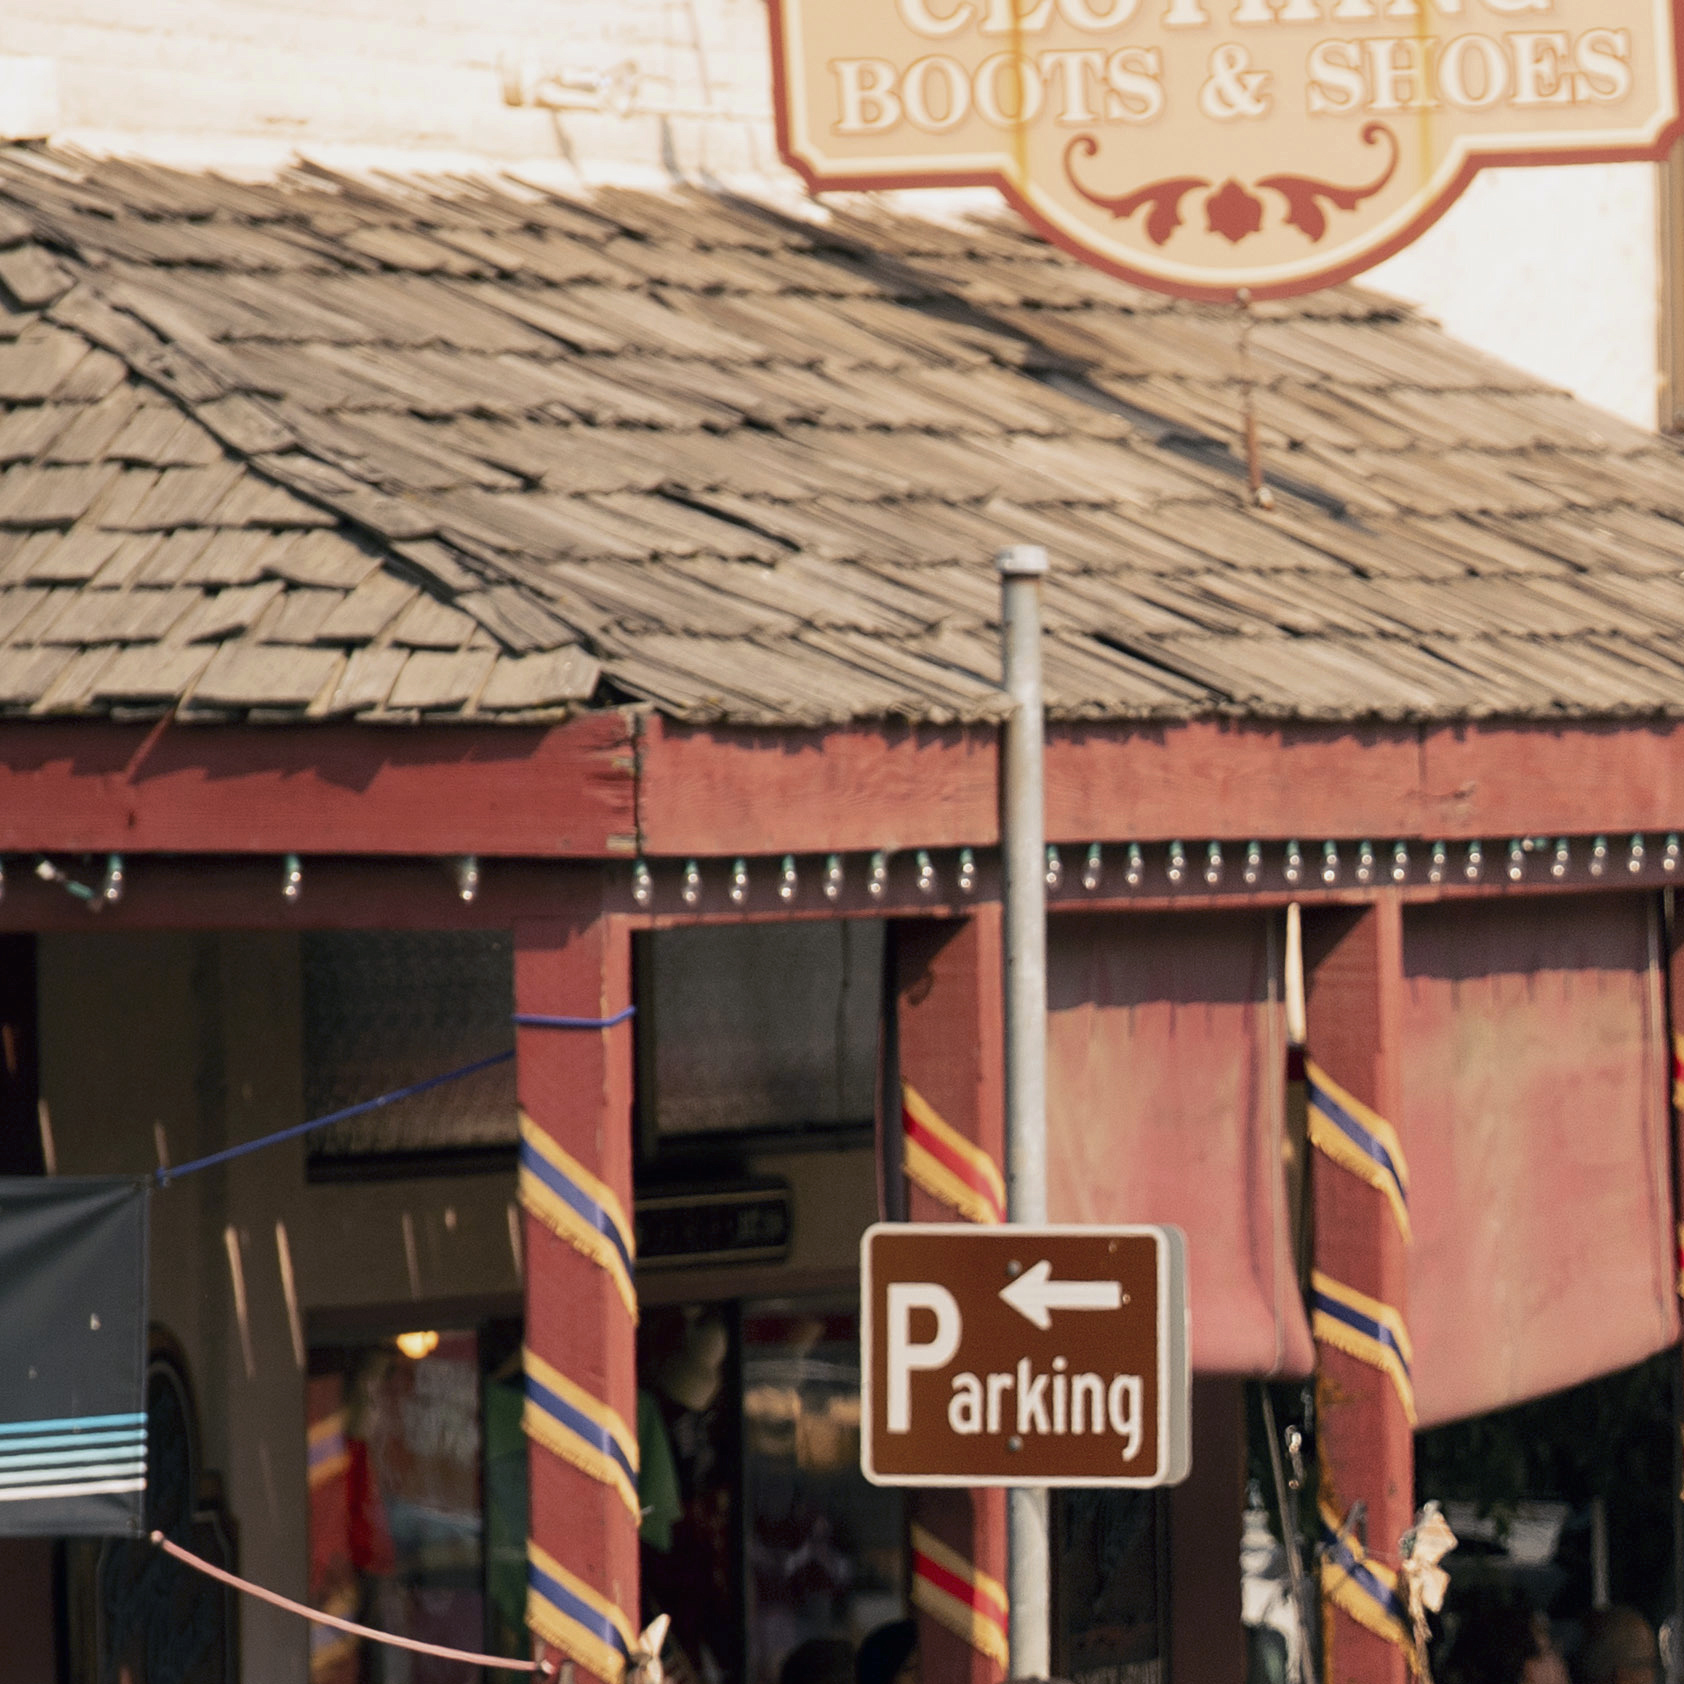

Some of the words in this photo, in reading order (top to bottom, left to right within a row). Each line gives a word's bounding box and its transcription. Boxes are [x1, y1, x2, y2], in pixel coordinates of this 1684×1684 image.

[829, 44, 1167, 136] BOOTS
[1199, 42, 1273, 122] &
[1306, 26, 1632, 113] SHOES
[886, 1281, 1144, 1462] Parking
